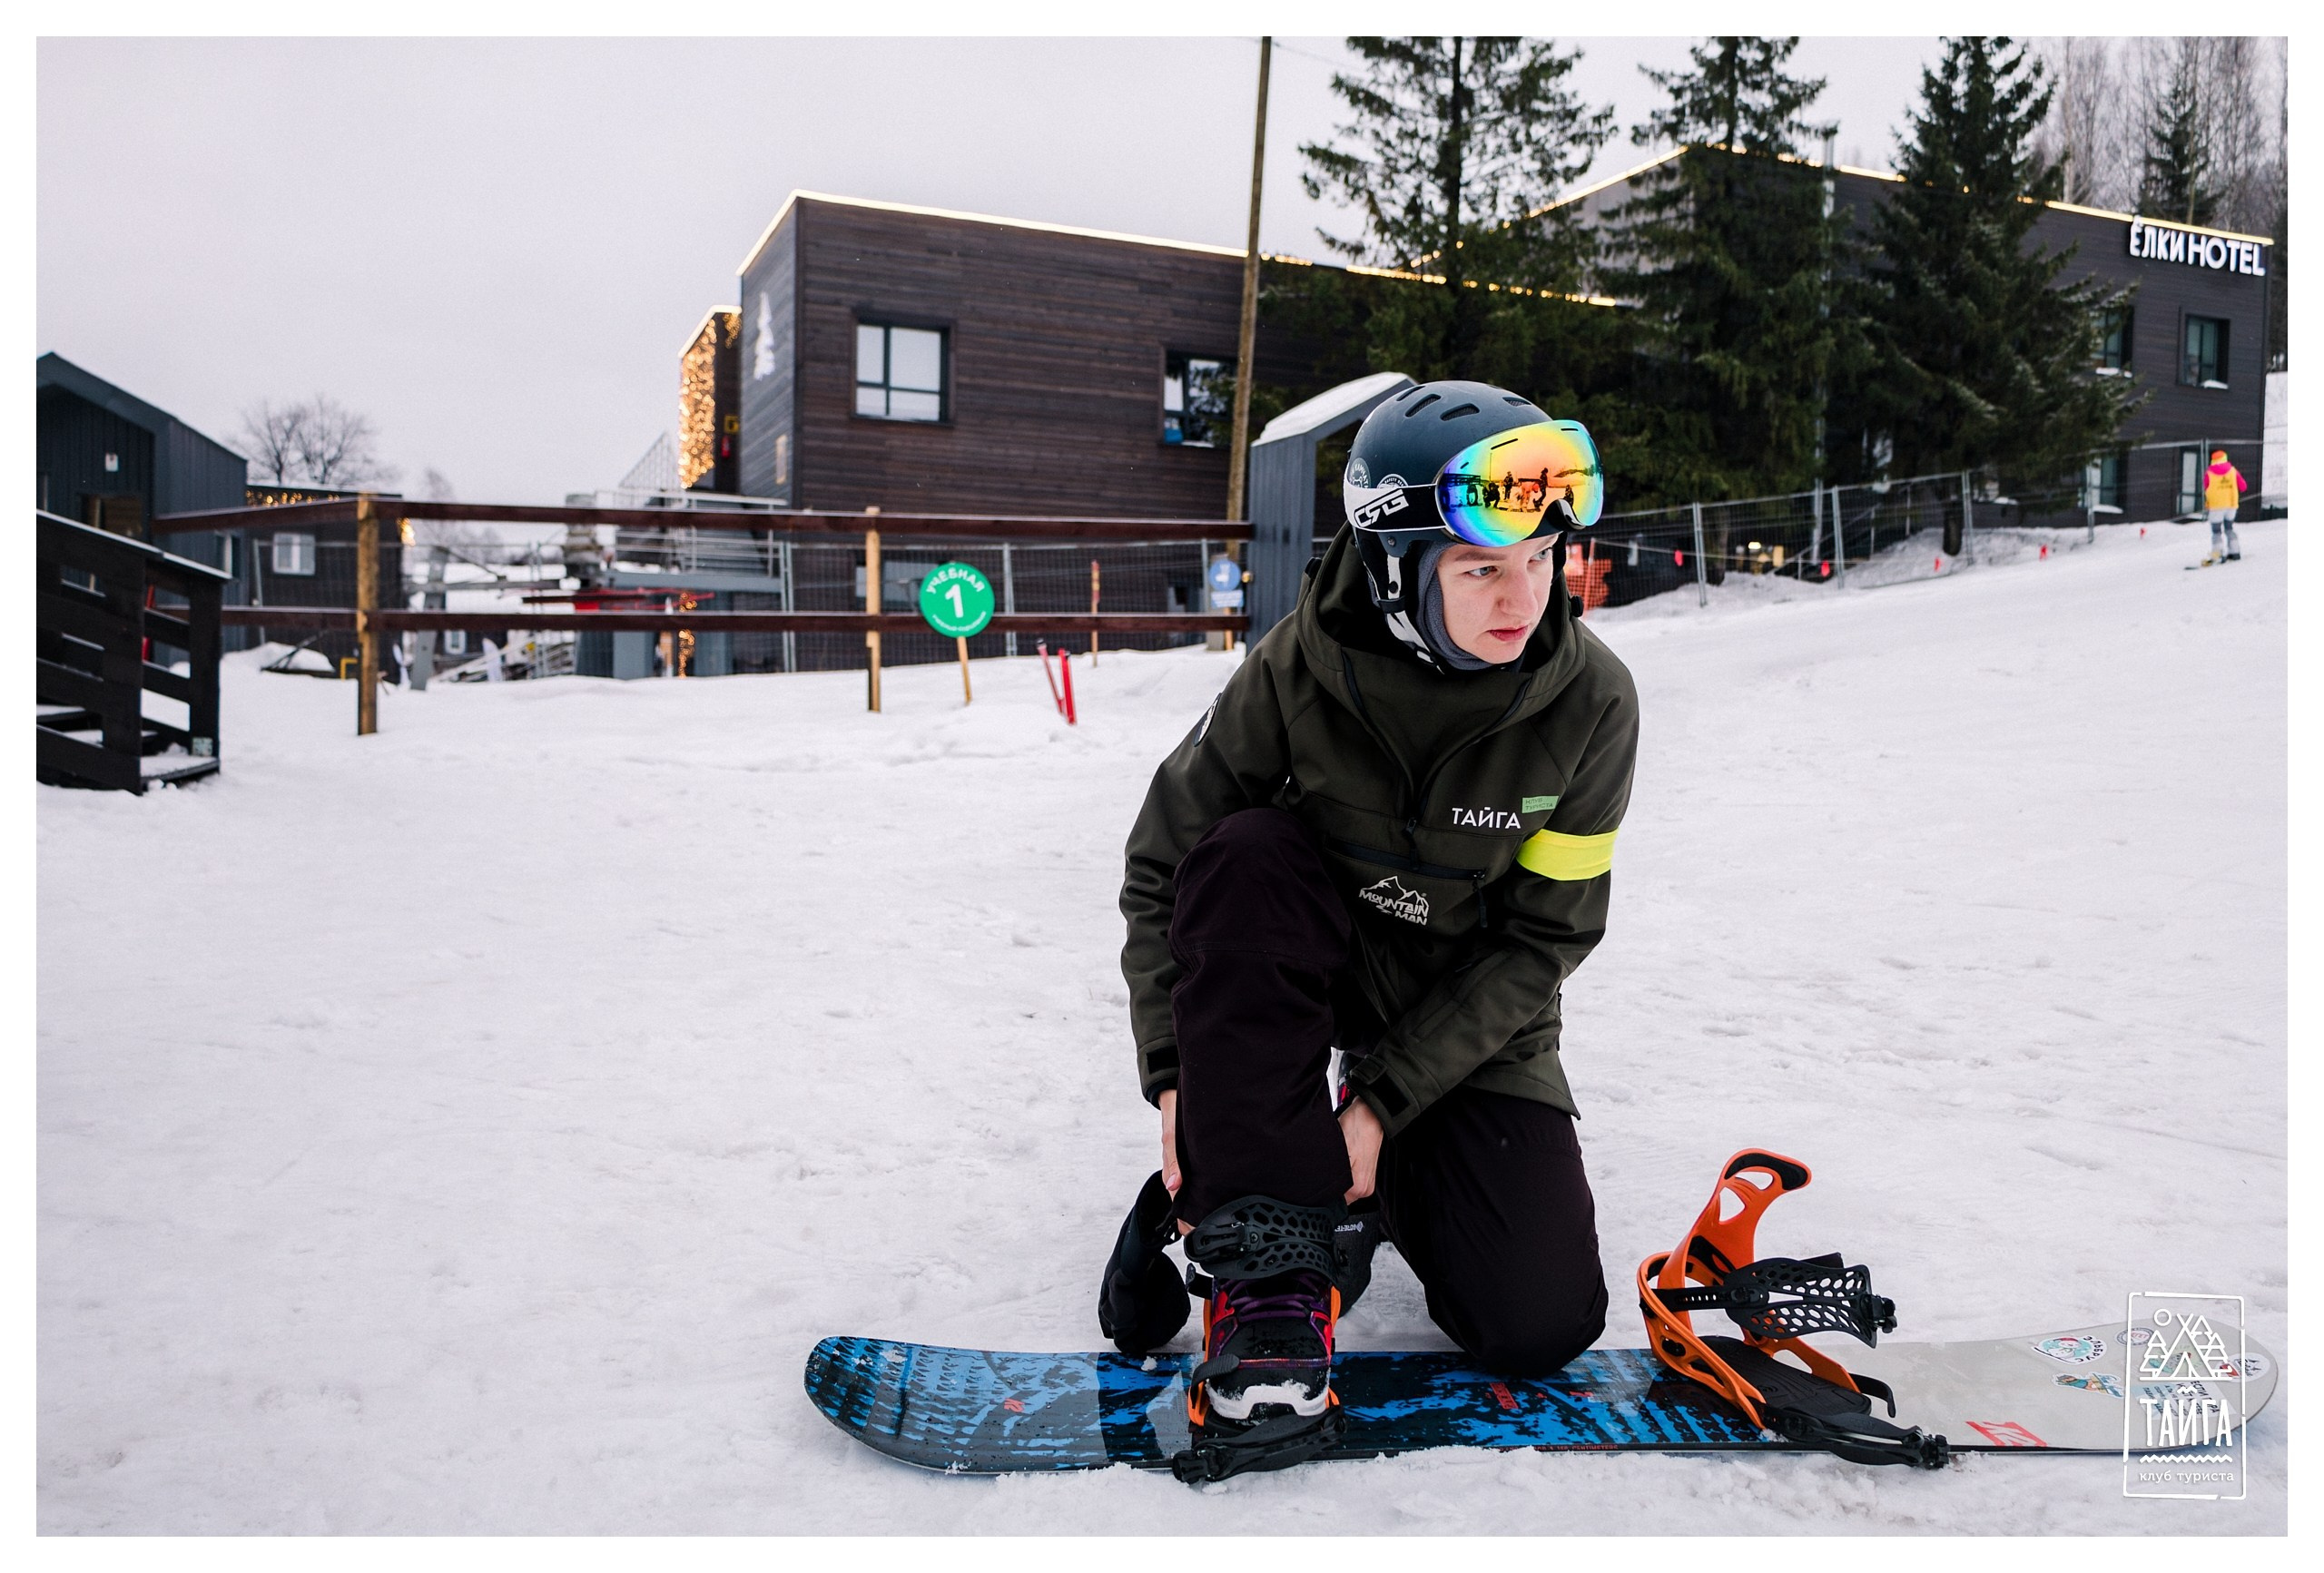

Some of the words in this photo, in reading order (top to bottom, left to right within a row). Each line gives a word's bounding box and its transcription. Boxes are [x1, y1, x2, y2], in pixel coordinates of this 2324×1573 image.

[2130, 216, 2185, 263] ЁЛКИ
[2187, 232, 2266, 277] HOTEL
[926, 566, 985, 594] УЧЕБНАЯ
[945, 584, 964, 618] 1
[1452, 806, 1521, 829] ТАЙГА
[1358, 890, 1429, 918] MOUNTAIN
[1394, 910, 1427, 926] MAN
